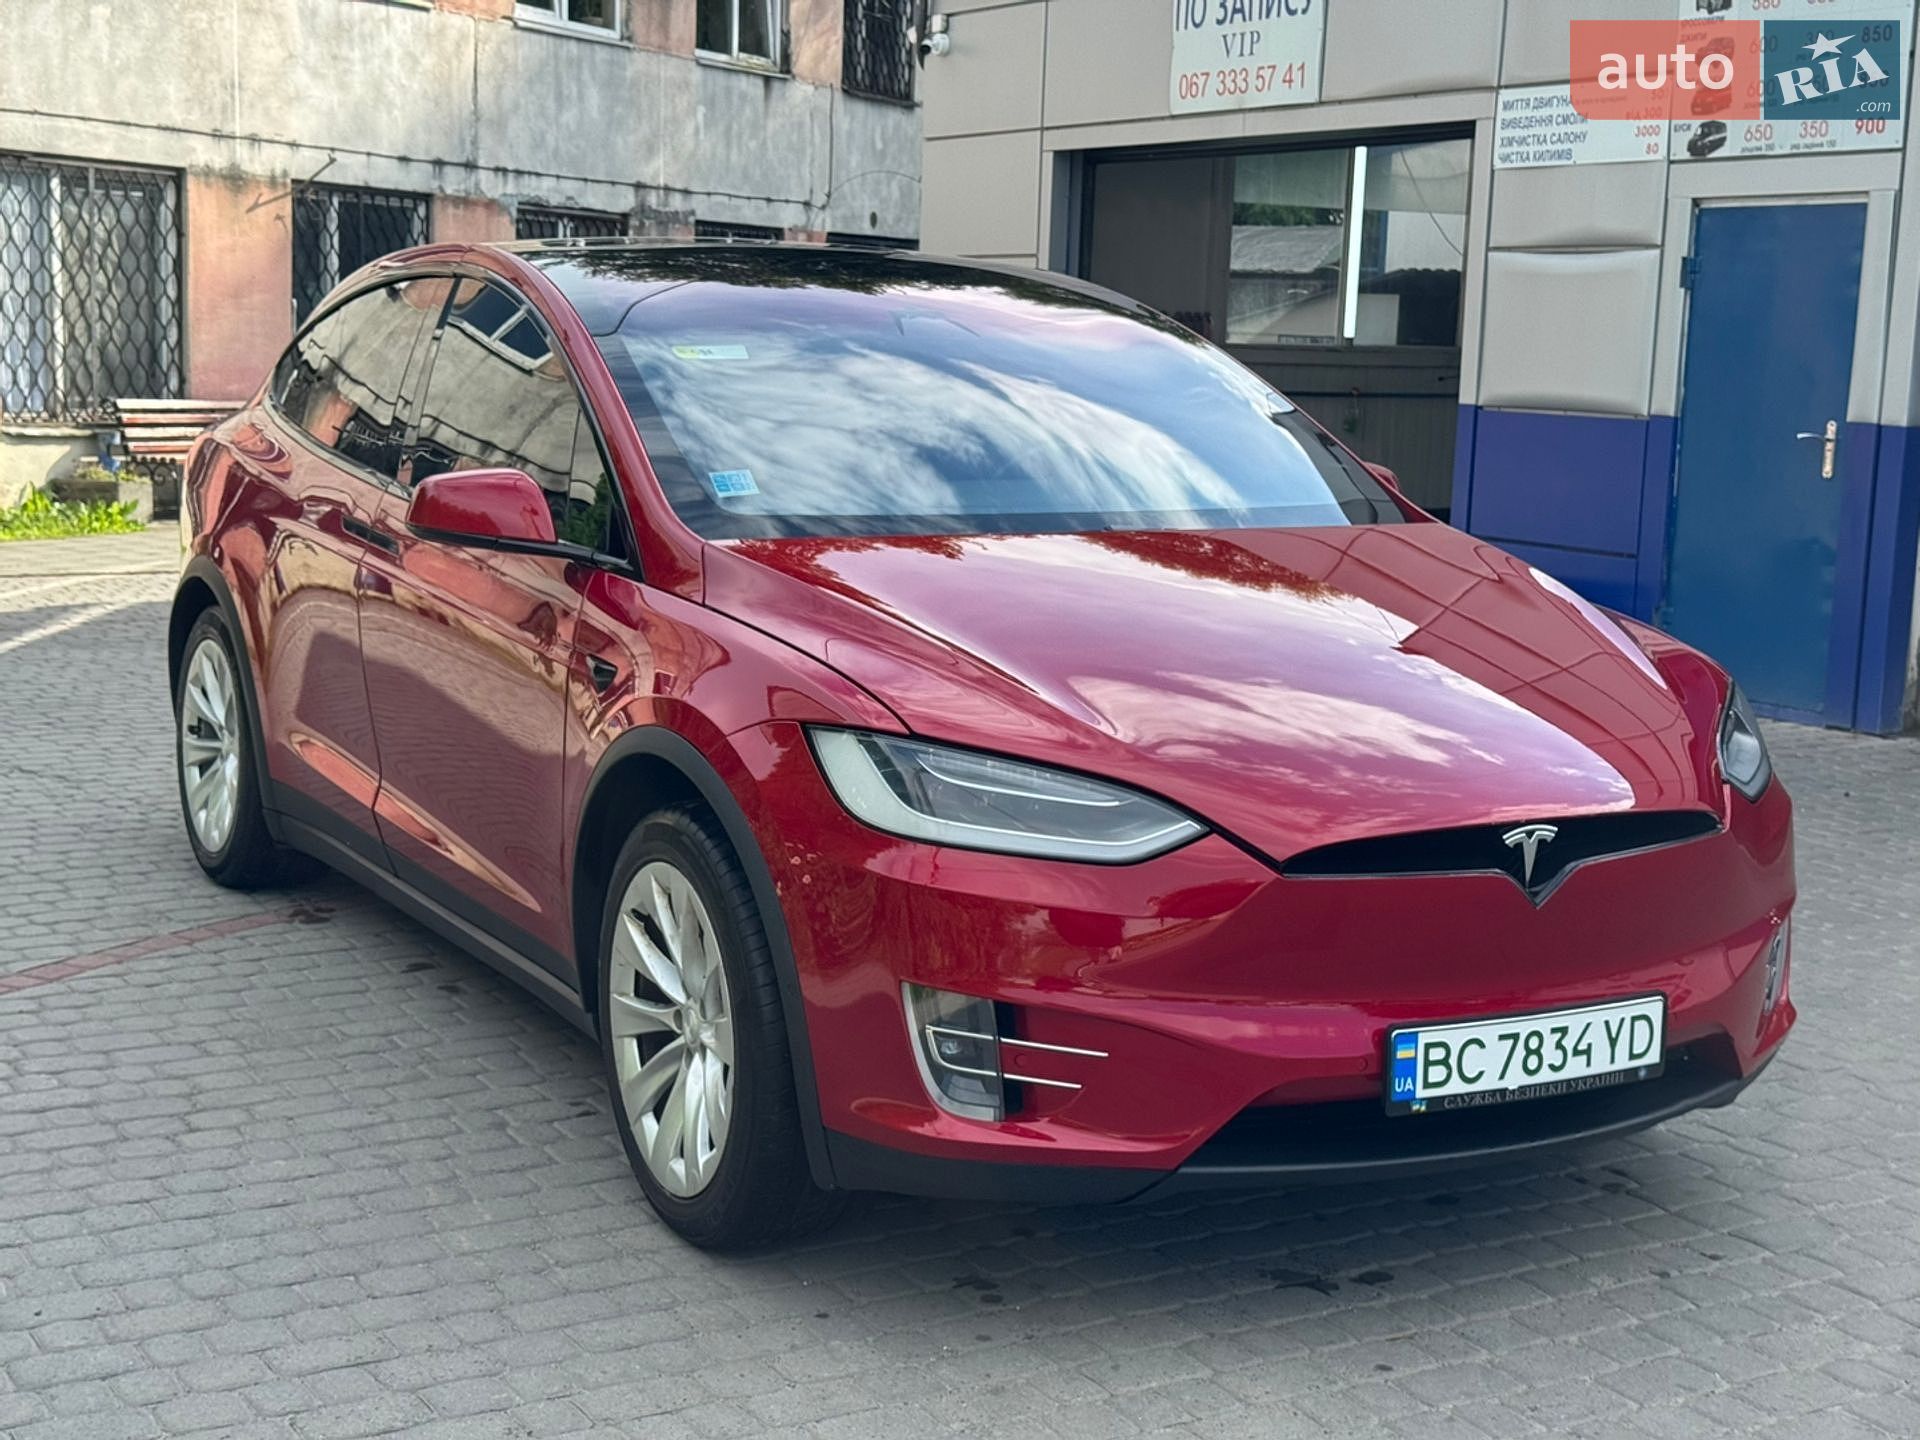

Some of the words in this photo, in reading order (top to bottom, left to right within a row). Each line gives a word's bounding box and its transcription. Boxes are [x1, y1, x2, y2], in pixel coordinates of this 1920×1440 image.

[1175, 0, 1207, 31] ПО
[1215, 0, 1311, 26] ЗАПИСУ
[1861, 24, 1893, 43] 850
[1222, 30, 1261, 58] VIP
[1178, 72, 1211, 100] 067
[1215, 68, 1249, 97] 333
[1254, 64, 1278, 93] 57
[1281, 61, 1306, 90] 41
[1502, 97, 1531, 112] МИТТЯ
[1500, 115, 1554, 131] ВИВЕДЕННЯ
[1799, 120, 1829, 139] 350
[1855, 118, 1886, 135] 900
[1548, 130, 1589, 146] САЛОНУ
[1743, 124, 1773, 143] 650
[1498, 149, 1531, 165] ЧИСТКА
[1422, 1037, 1487, 1091] BC
[1498, 1021, 1593, 1082] 7834
[1604, 1013, 1655, 1065] YD
[1395, 1076, 1415, 1093] UA
[1443, 1091, 1501, 1110] СЛУЖБА
